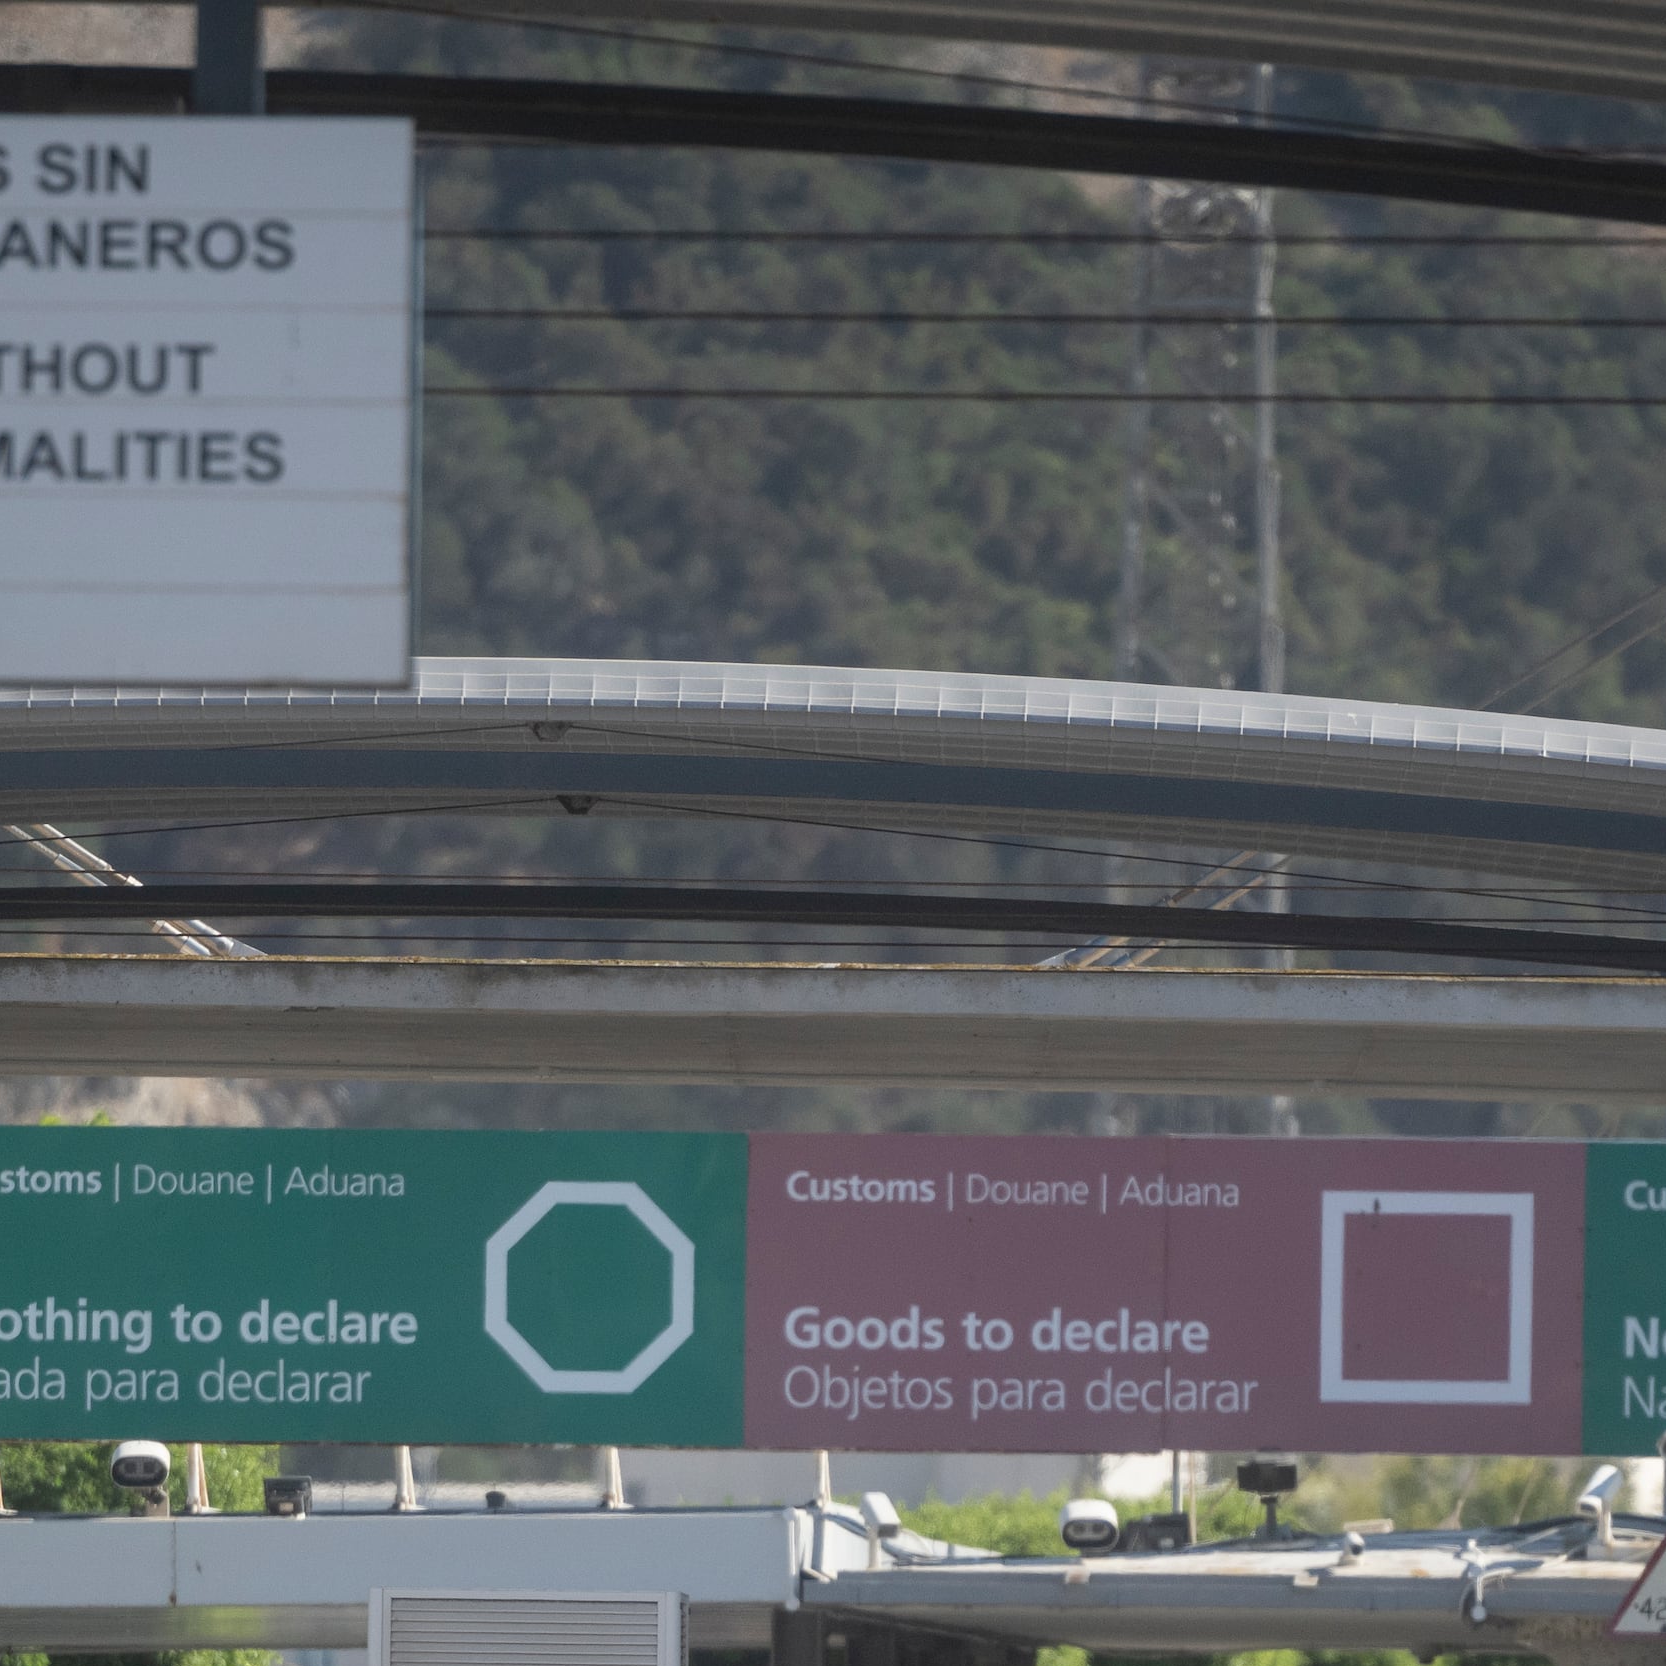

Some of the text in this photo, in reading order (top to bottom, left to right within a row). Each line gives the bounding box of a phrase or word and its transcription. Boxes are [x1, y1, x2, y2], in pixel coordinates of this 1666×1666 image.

[36, 146, 150, 196] SIN
[134, 1166, 254, 1196] Douane
[285, 1166, 405, 1197] Aduana
[786, 1170, 1239, 1207] Customs Douane Aduana
[171, 1304, 221, 1342] to
[240, 1300, 418, 1345] declare
[785, 1305, 1210, 1353] Goods to declare
[86, 1371, 179, 1410] para
[198, 1360, 371, 1402] declarar
[785, 1365, 1258, 1420] Objetos para declarar
